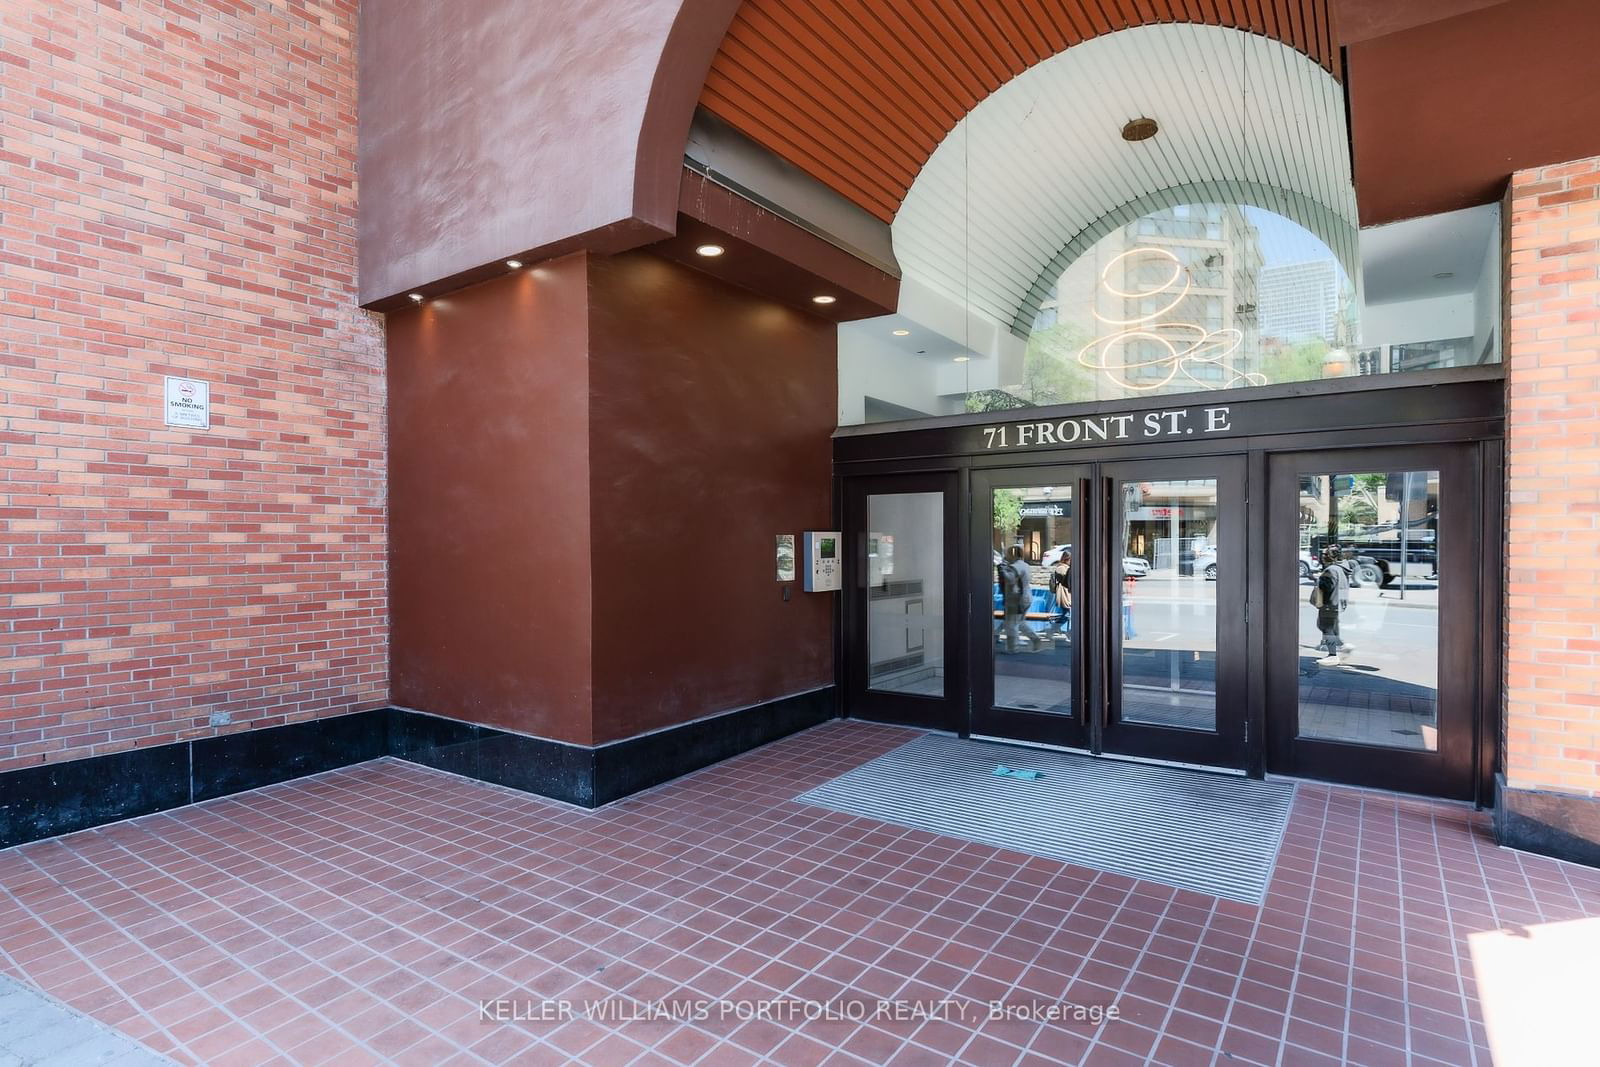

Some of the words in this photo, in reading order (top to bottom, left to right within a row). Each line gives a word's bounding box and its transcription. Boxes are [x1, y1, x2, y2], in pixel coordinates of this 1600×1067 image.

[170, 400, 204, 410] SMOKING
[983, 427, 1008, 448] 71
[1016, 414, 1134, 446] FRONT
[1144, 409, 1193, 437] ST.
[1204, 407, 1231, 432] E
